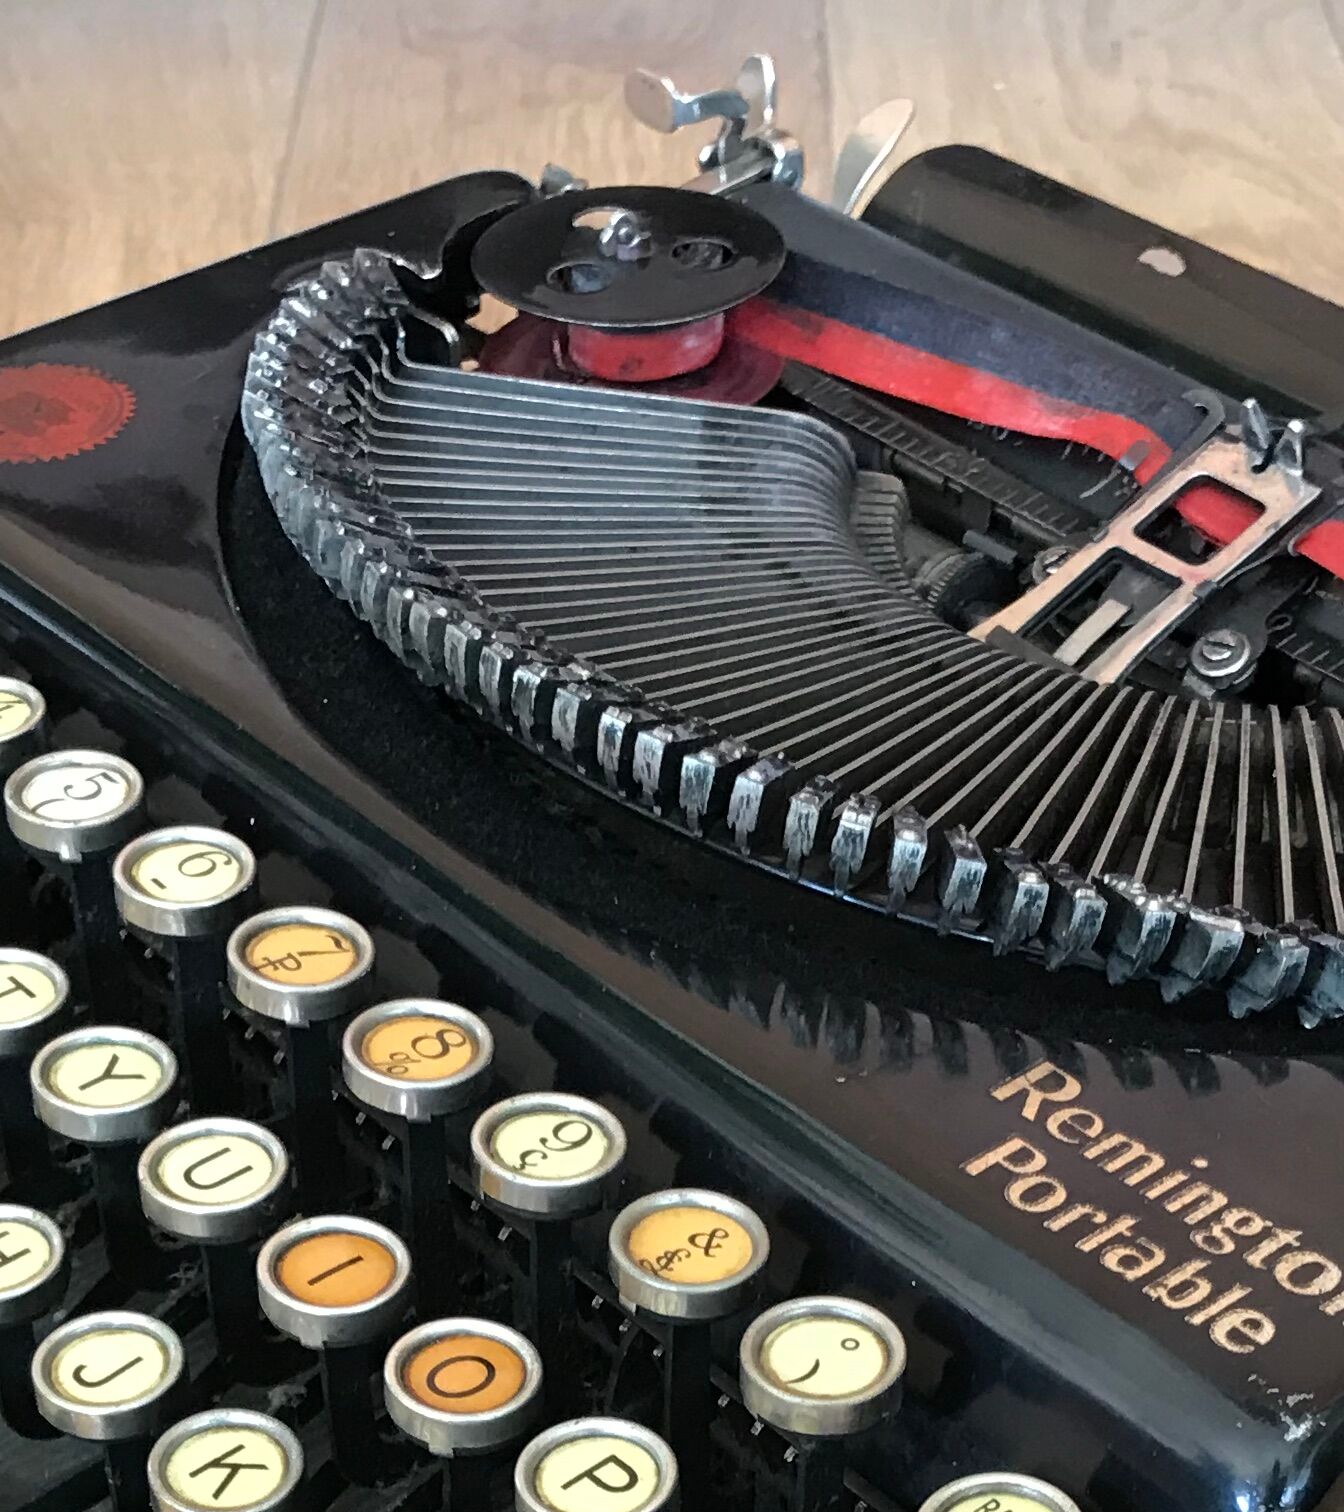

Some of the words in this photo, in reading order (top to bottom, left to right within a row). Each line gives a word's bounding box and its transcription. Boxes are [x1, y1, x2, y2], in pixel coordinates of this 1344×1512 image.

[64, 772, 119, 801] 5
[177, 851, 233, 878] 6
[411, 1028, 466, 1060] 8
[77, 1053, 147, 1092] Y
[539, 1120, 593, 1152] 9
[182, 1146, 255, 1191] U
[958, 1134, 1278, 1355] Portable
[306, 1255, 365, 1288] I
[71, 1355, 145, 1390] J
[425, 1355, 497, 1399] O
[188, 1443, 270, 1501] K
[560, 1453, 640, 1494] P
